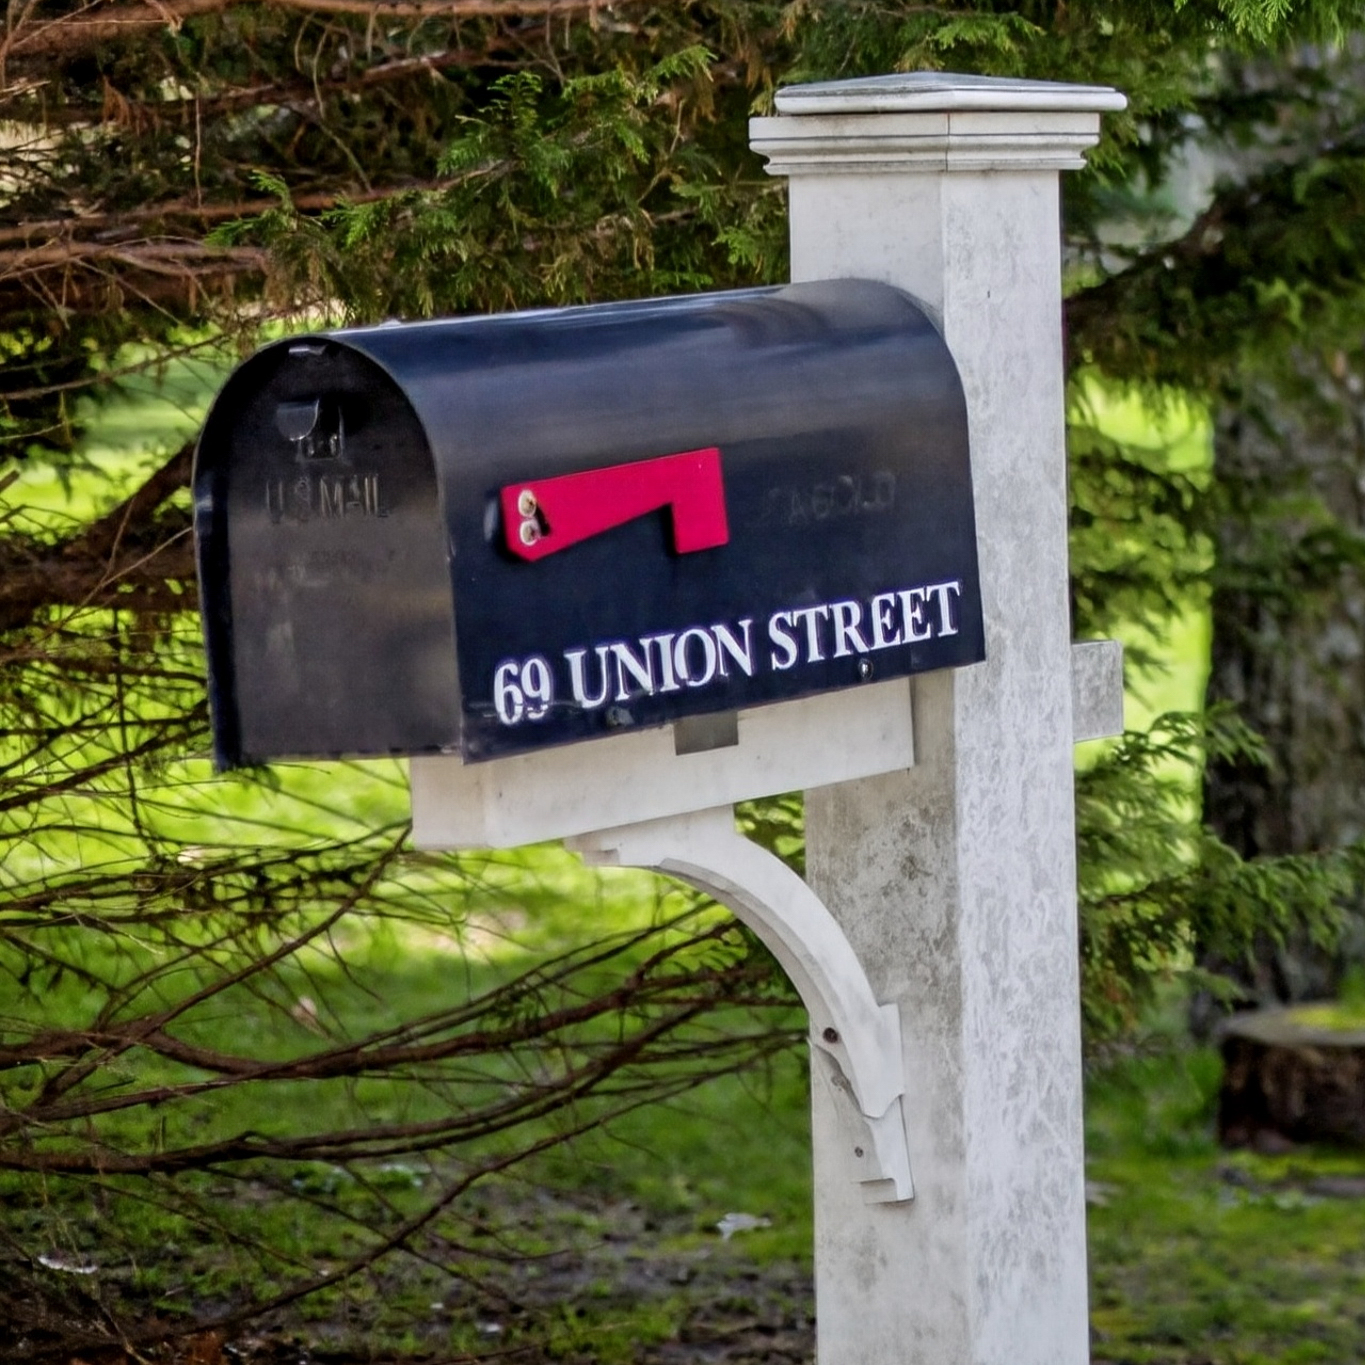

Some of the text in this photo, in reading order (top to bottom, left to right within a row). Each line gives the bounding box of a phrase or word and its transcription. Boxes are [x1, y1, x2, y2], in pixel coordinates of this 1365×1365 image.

[493, 581, 960, 725] 69 UNION STREET
